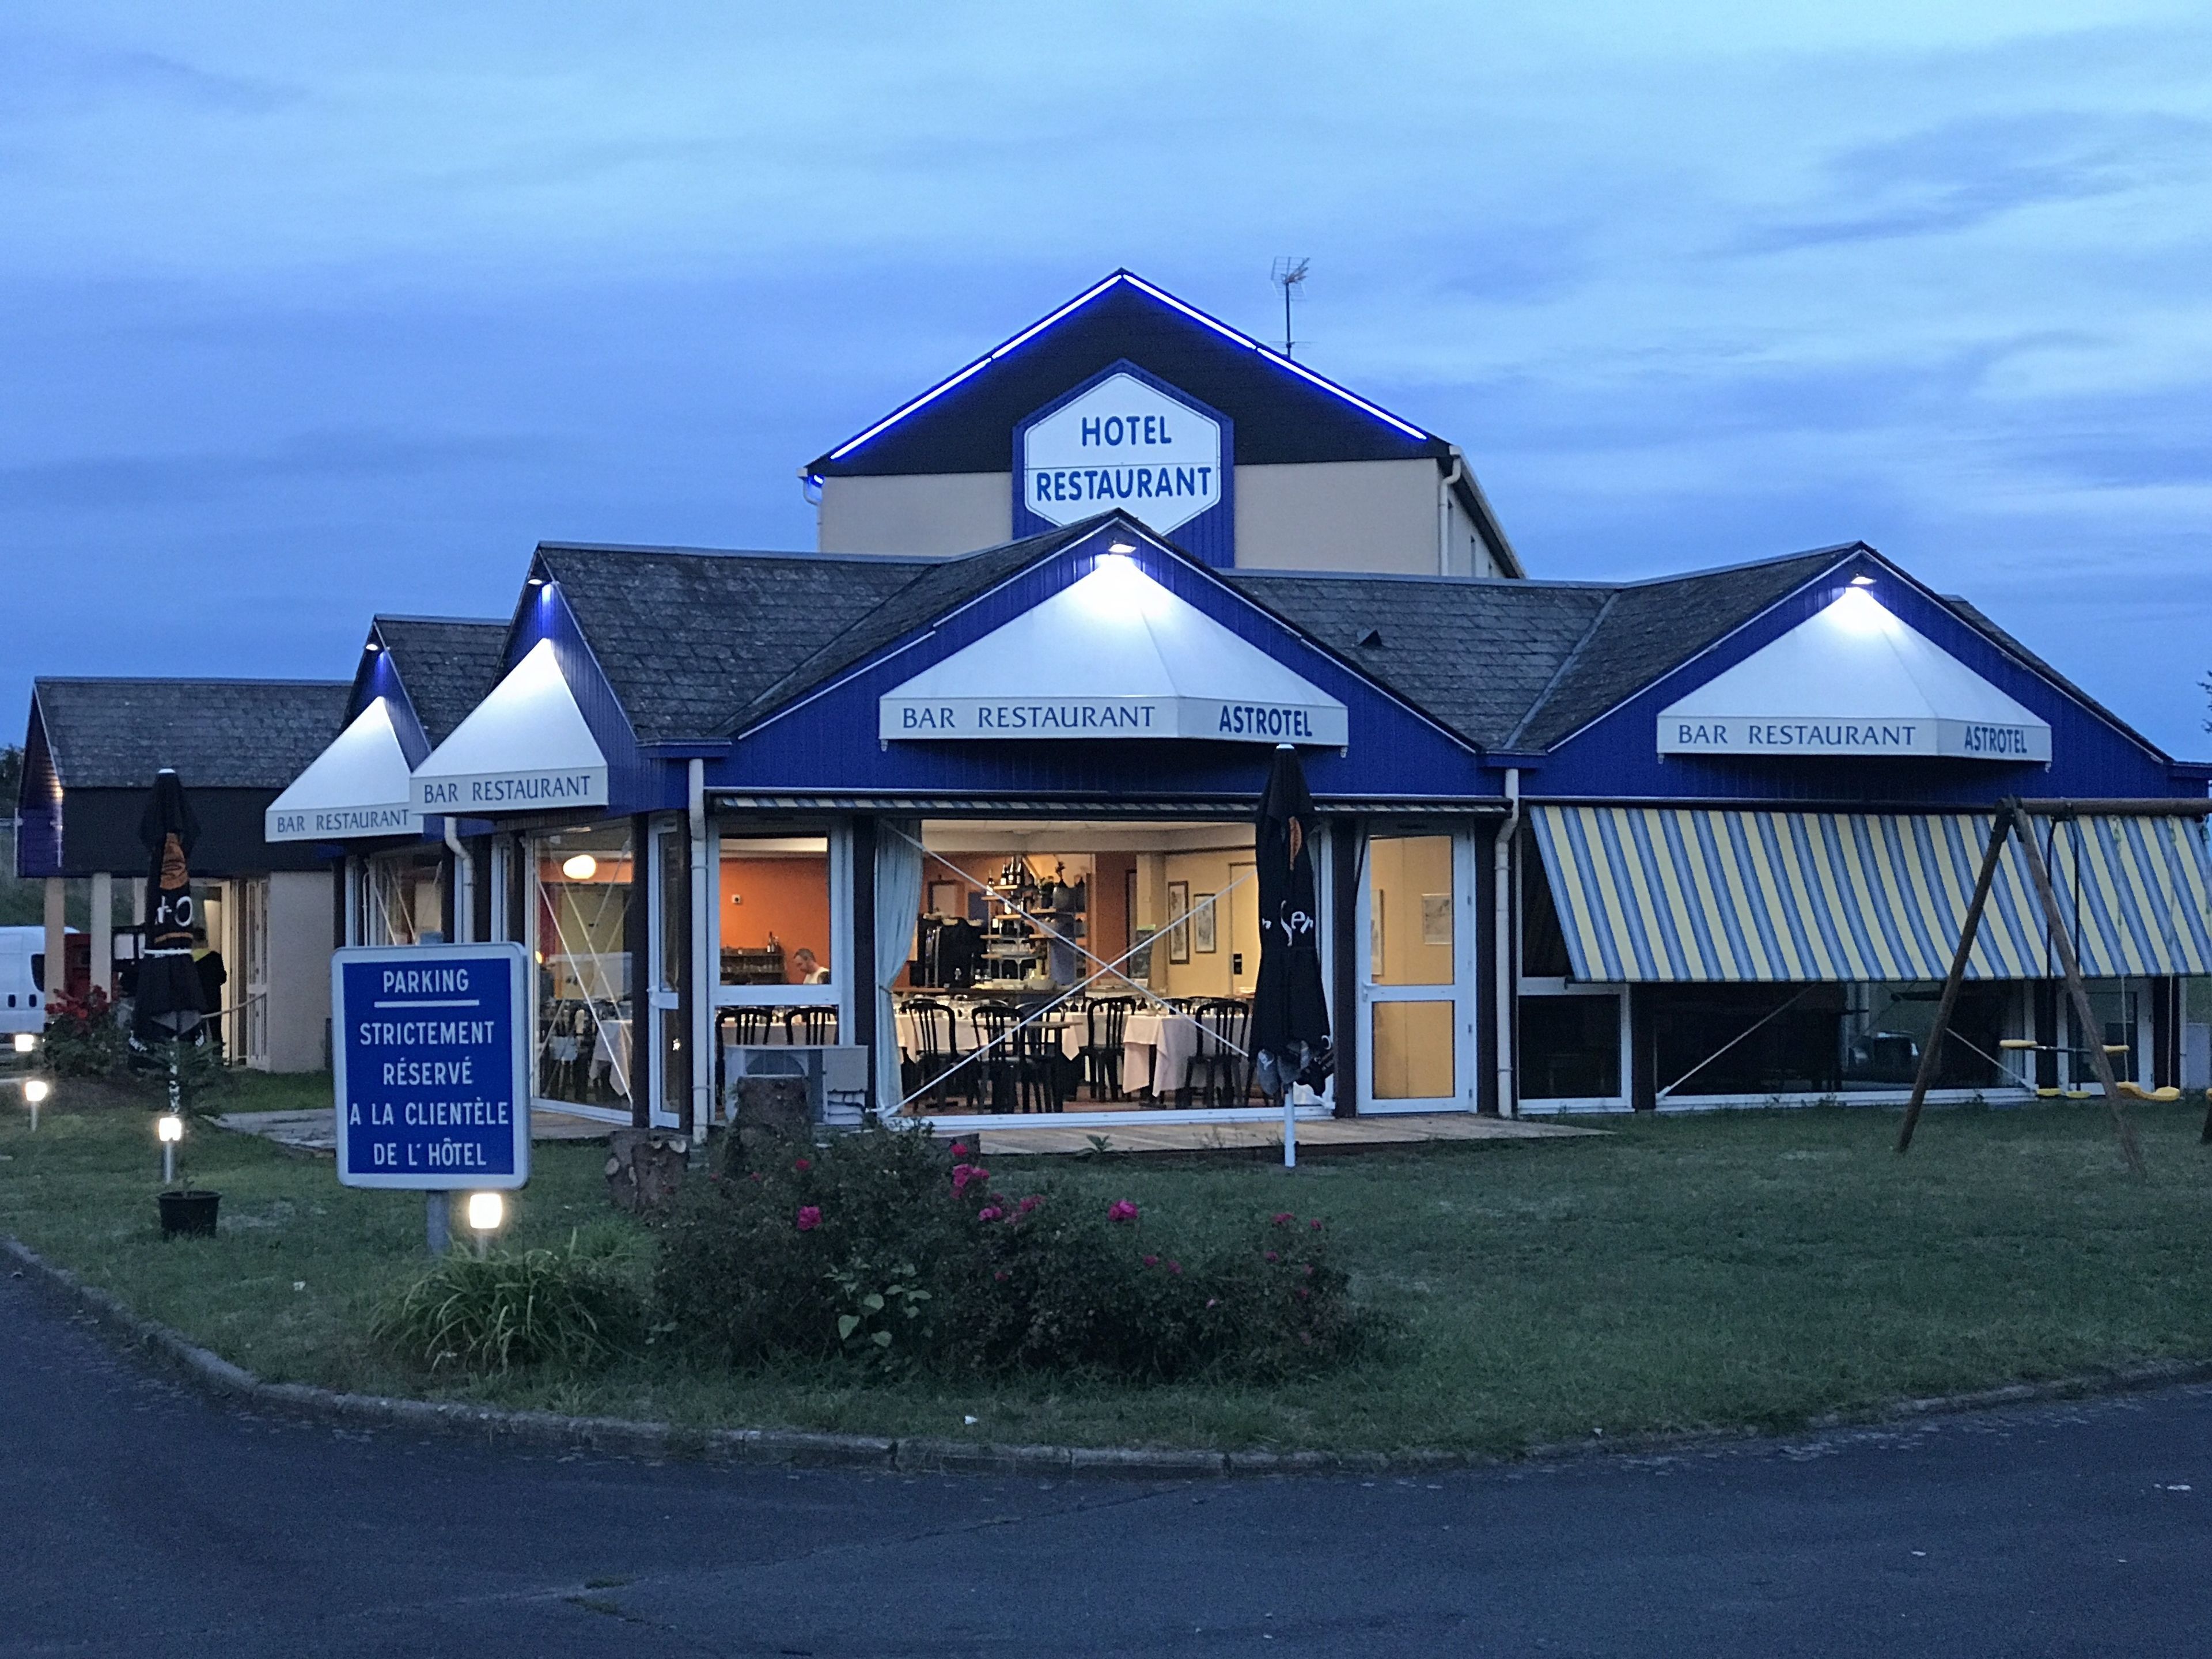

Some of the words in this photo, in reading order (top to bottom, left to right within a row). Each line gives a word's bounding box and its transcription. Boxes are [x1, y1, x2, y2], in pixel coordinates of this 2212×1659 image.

[1082, 415, 1172, 446] HOTEL
[1036, 467, 1211, 501] RESTAURANT
[903, 707, 955, 728] BAR
[978, 706, 1156, 728] RESTAURANT
[1219, 705, 1313, 736] ASTROTEL
[1679, 725, 1728, 744] BAR
[1749, 726, 1916, 745] RESTAURANT
[1964, 726, 2027, 753] ASTROTEL
[424, 783, 459, 804] BAR
[472, 775, 590, 801] RESTAURANT
[277, 817, 305, 832] BAR
[316, 809, 409, 831] RESTAURANT
[383, 968, 469, 993] PARKING
[359, 1021, 495, 1046] STRICTEMENT
[383, 1056, 473, 1085] RÉSERVÉ
[350, 1104, 362, 1125] A
[372, 1103, 394, 1125] LA
[405, 1097, 509, 1125] CLIENTÈLE
[374, 1143, 397, 1165] DE
[429, 1138, 487, 1166] HÔTEL
